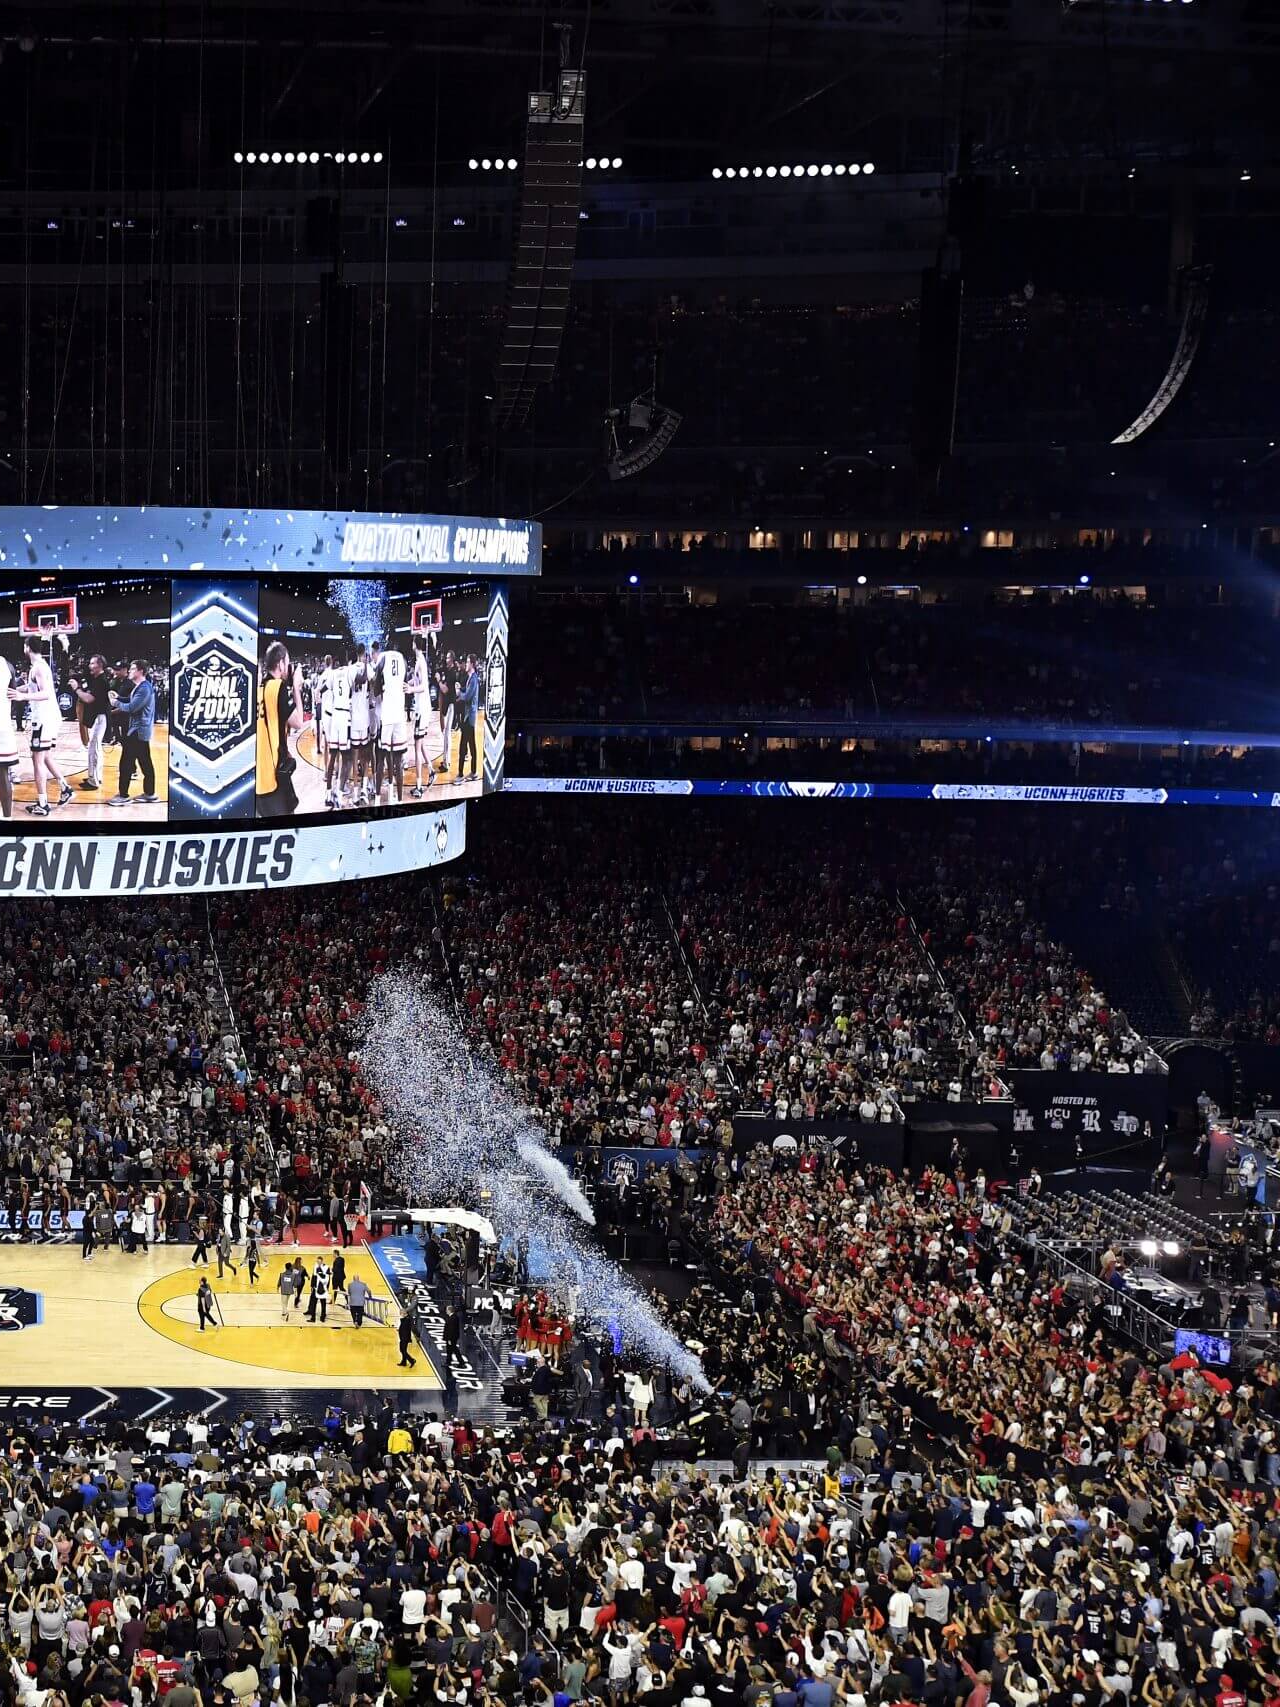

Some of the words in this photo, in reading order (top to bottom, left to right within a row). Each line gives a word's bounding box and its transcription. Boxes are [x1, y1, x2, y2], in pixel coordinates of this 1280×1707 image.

[341, 522, 450, 563] NATIONAL
[453, 527, 530, 565] CHAMPIONS
[189, 676, 239, 698] FINAL
[193, 697, 242, 720] FOUR
[564, 779, 604, 791] UCONN
[606, 780, 655, 793] HUSKIES
[1024, 787, 1067, 799] UCONN
[1070, 788, 1126, 801] HUSKIES
[110, 834, 295, 889] HUSKIES
[1052, 1096, 1083, 1105] HOSTED
[1084, 1097, 1098, 1106] BY:
[1044, 1108, 1071, 1119] HCU
[381, 1246, 417, 1275] NCAA
[1089, 1622, 1099, 1634] 15
